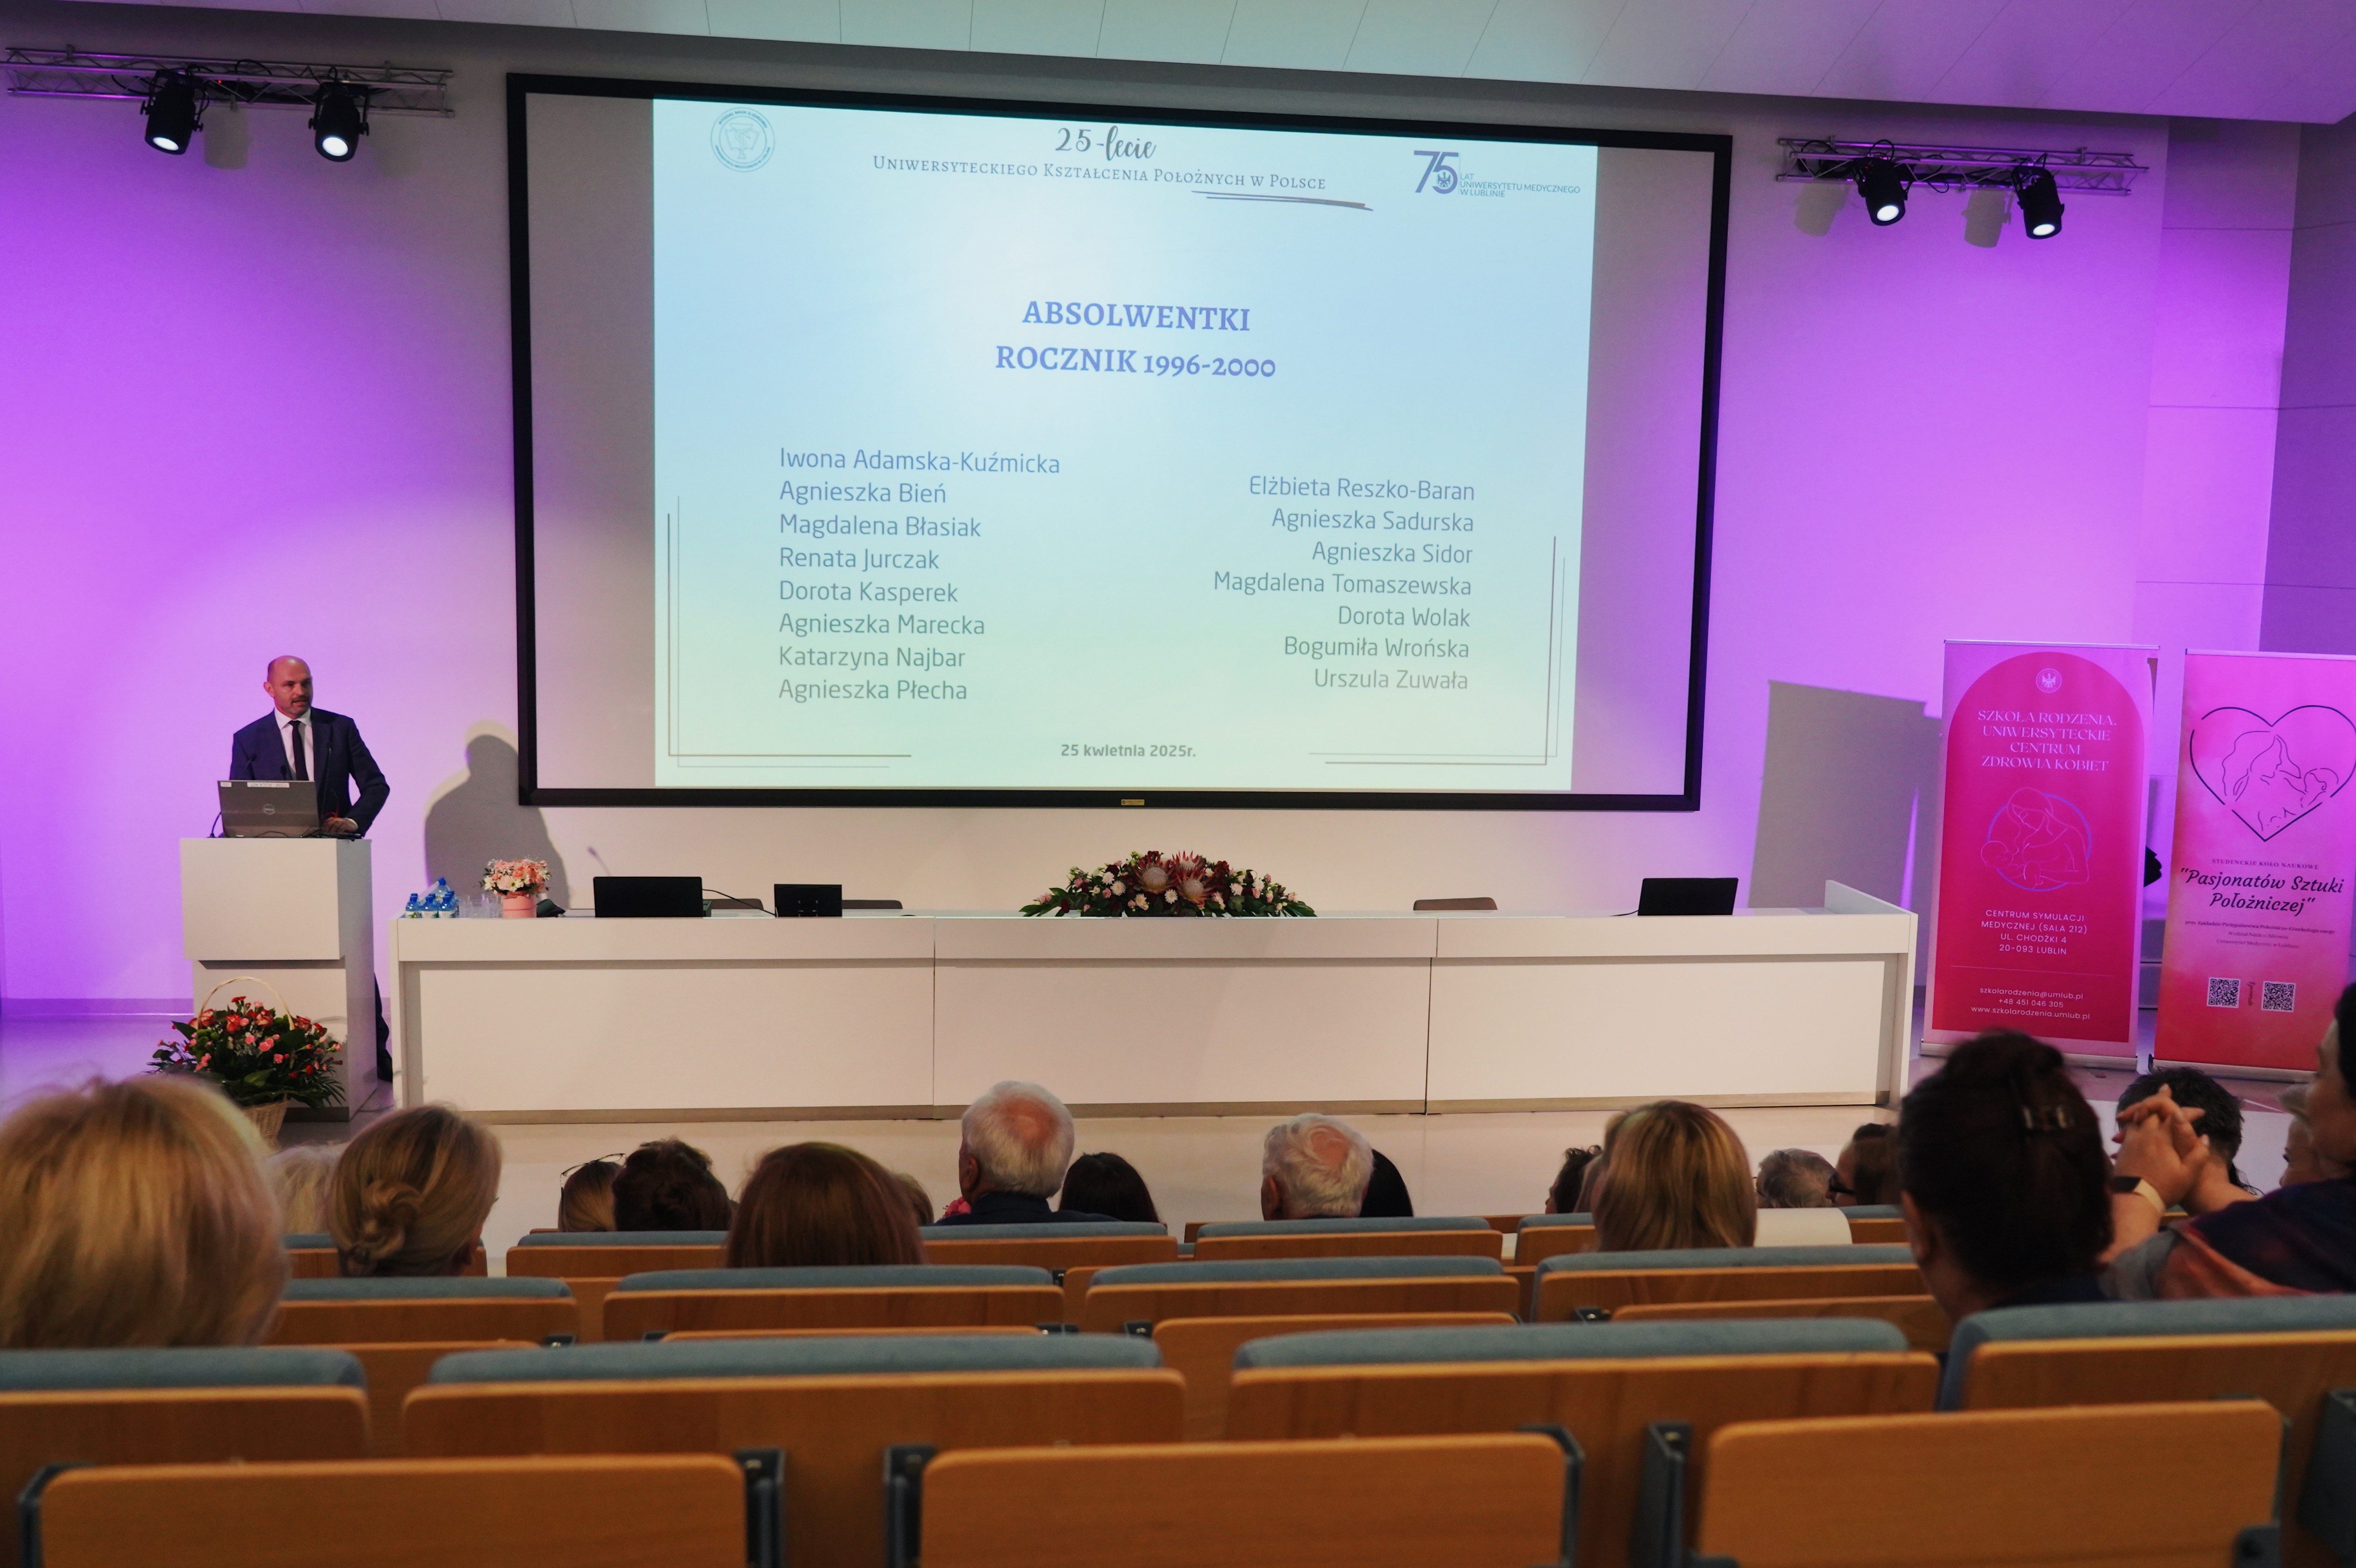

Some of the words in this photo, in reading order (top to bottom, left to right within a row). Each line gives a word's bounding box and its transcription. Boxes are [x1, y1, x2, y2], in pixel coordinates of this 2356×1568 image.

[1055, 125, 1156, 161] 25-lecie
[874, 156, 1037, 176] UNIWERSYTECKIEGO
[1270, 174, 1325, 189] POLSCE
[1414, 150, 1459, 194] 75
[1460, 181, 1522, 190] UNIWERSYTETU
[1524, 184, 1580, 194] MEDYCZNEGO
[1022, 301, 1250, 331] ABSOLWENTKI
[996, 346, 1137, 373] ROCZNIK
[1144, 354, 1276, 377] 1996-2000
[781, 448, 845, 468] Iwona
[854, 449, 1059, 473] Adamska-Kuźmicka
[780, 481, 890, 505] Agnieszka
[900, 483, 945, 503] Bień
[1250, 476, 1329, 496] Elżbieta
[1338, 478, 1474, 500] Reszko-Baran
[781, 514, 897, 539] Magdalena
[907, 516, 981, 536] Błasiak
[1272, 508, 1375, 532] Agnieszka
[1383, 511, 1473, 531] Sadurska
[781, 547, 856, 567] Renata
[862, 549, 939, 572] Jurczak
[1312, 542, 1415, 565] Agnieszka
[1423, 544, 1472, 563] Sidor
[780, 581, 851, 600] Dorota
[860, 581, 958, 606] Kasperek
[1215, 571, 1324, 595] Magdalena
[1332, 574, 1471, 595] Tomaszewska
[779, 613, 889, 637] Agnieszka
[898, 614, 984, 634] Marecka
[1339, 606, 1404, 625] Dorota
[1412, 608, 1470, 627] Wolak
[780, 646, 888, 671] Katarzyna
[897, 647, 965, 671] Najbar
[1285, 636, 1377, 660] Bogumiła
[1385, 638, 1468, 657] Wrońska
[1315, 668, 1388, 687] Urszula
[1396, 670, 1467, 689] Zuwała
[779, 679, 889, 703] Agnieszka
[898, 680, 967, 699] Płecha
[1978, 710, 2035, 722] SZKOŁA
[1983, 725, 2110, 740] UNIWERSYTECKIE
[1061, 744, 1079, 756] 25
[1084, 744, 1145, 756] kwietnia
[1150, 745, 1196, 757] 2025r.
[2010, 742, 2080, 755] CENTRUM
[1982, 756, 2051, 769] ZDROWIA
[2055, 759, 2108, 771] KOBIET
[2181, 868, 2285, 889] "Pasjonatów
[2291, 876, 2344, 893] Sztuki
[1985, 909, 2029, 918] CENTRUM
[2033, 912, 2084, 921] SYMULACJI
[1981, 921, 2035, 930] MEDYCZNEJ
[2039, 922, 2065, 932] (SALA
[2069, 925, 2087, 934] 212)
[2016, 934, 2058, 942] CHODŹKI
[1999, 944, 2033, 953] 20-093
[1980, 988, 2083, 1000] szkolarodzenia@umlub.pl
[1971, 1007, 2090, 1020] www.szkolarodzenia.umlub.pl
